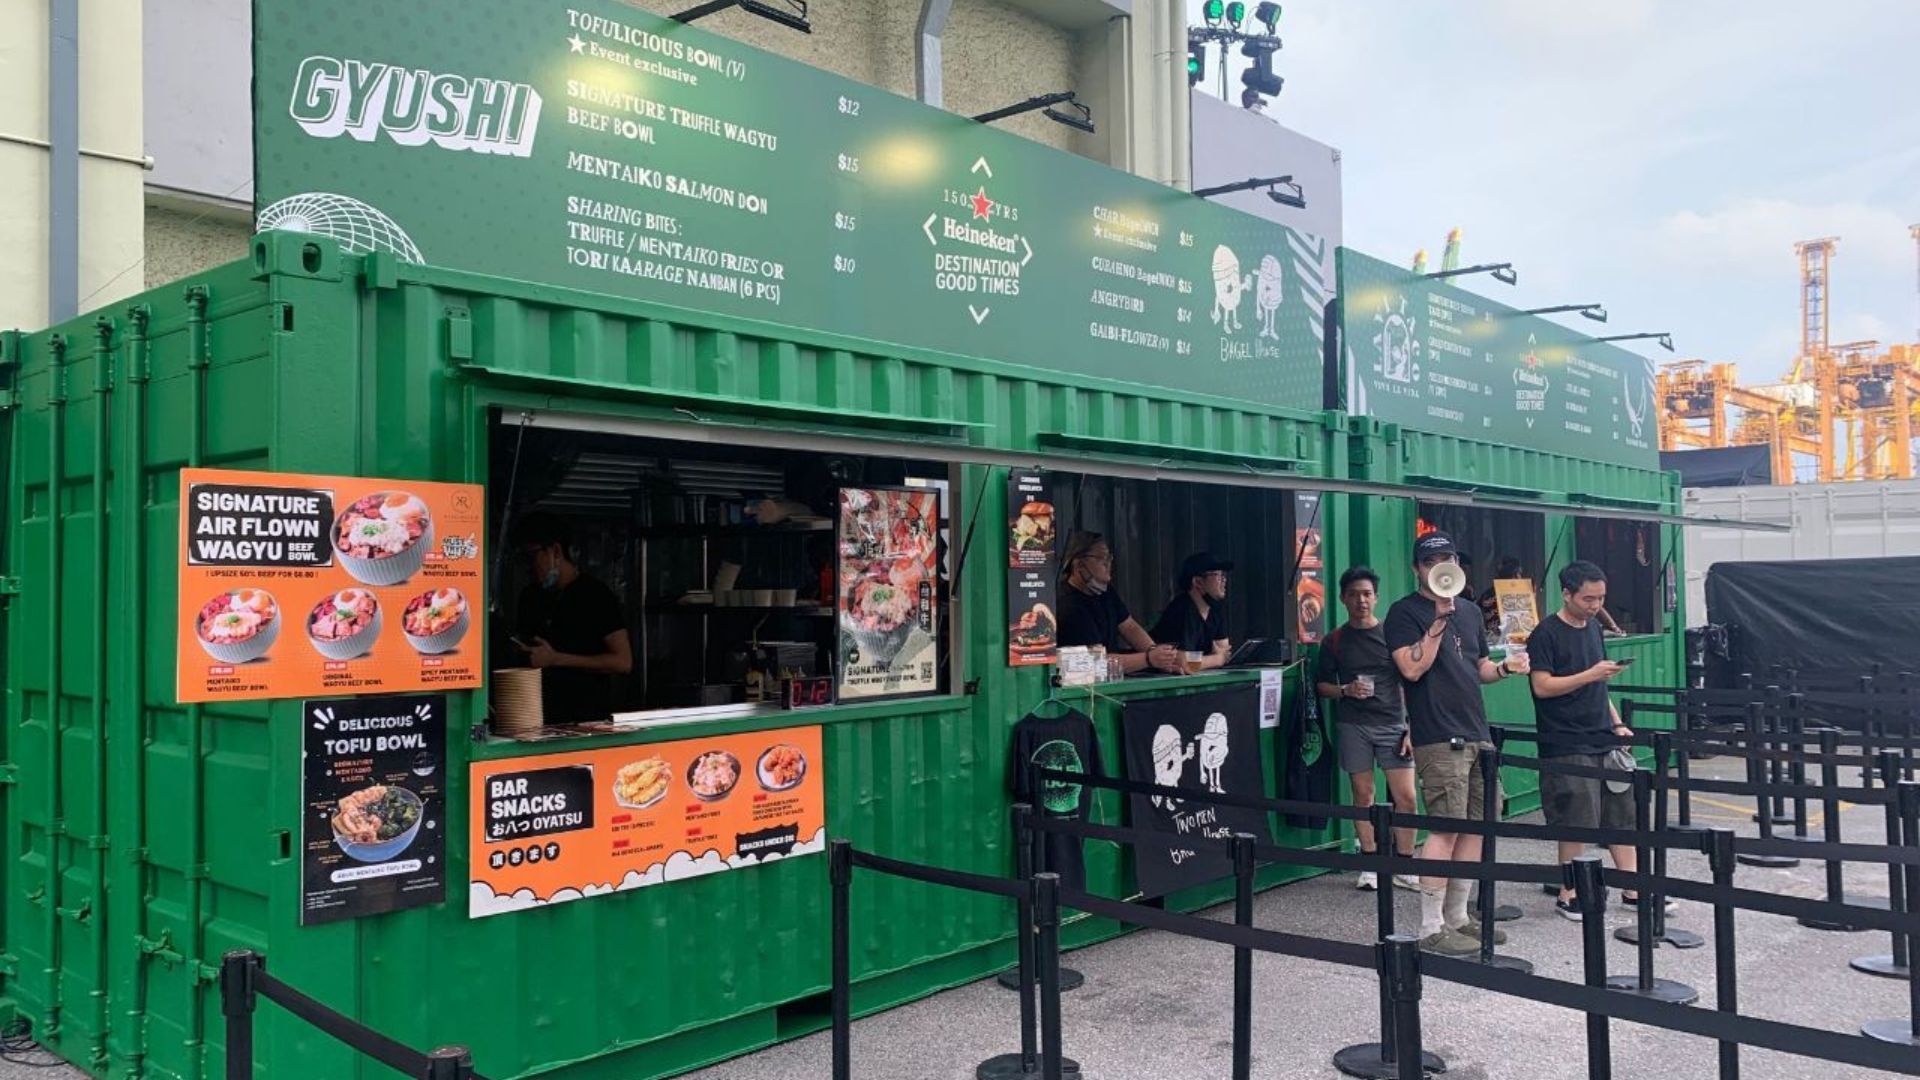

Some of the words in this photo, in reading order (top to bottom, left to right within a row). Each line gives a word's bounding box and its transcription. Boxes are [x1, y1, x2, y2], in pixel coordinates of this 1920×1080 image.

[566, 9, 683, 60] TOFULICIOUS
[687, 46, 725, 74] BOWL
[590, 41, 631, 66] Event
[634, 58, 698, 86] exclusive
[289, 55, 542, 158] GYUSHI
[567, 80, 666, 121] SIGNATURE
[670, 107, 721, 137] TRUFFLE
[723, 122, 777, 151] WAGYU
[838, 95, 861, 117] $12
[567, 107, 610, 132] BEEF
[614, 117, 656, 145] BOWL
[838, 152, 859, 173] $15
[567, 151, 662, 190] MENTAIKO
[665, 175, 735, 207] SALMON
[737, 192, 768, 216] DON
[567, 196, 641, 227] SHARING
[645, 212, 682, 237] BITES:
[944, 189, 967, 207] 150
[995, 203, 1018, 221] YRS
[835, 211, 856, 232] $15
[943, 217, 1016, 254] Heineken
[567, 221, 625, 249] TRUFFLE
[639, 235, 718, 267] MENTAIKO
[720, 252, 759, 275] FRIES
[761, 261, 785, 280] OR
[566, 246, 609, 271] TORI
[756, 282, 781, 306] PCS)
[834, 254, 856, 274] $10
[935, 253, 1020, 278] DESTINATION
[936, 272, 977, 292] GOOD
[981, 276, 1020, 296] TIMES
[1091, 289, 1145, 313] ANGRYBIRD
[197, 492, 319, 515] SIGNATURE
[196, 515, 236, 535] AIR
[241, 518, 319, 538] FLOWN
[196, 540, 282, 560] WAGYU
[288, 542, 314, 551] BEEF
[288, 551, 319, 561] BOWL
[339, 715, 414, 731] DELICIOUS
[324, 738, 372, 755] TOFU
[376, 733, 427, 751] BOWL
[491, 778, 528, 798] BAR
[491, 793, 566, 819] SNACKS
[492, 819, 531, 837] お八つ
[533, 812, 583, 831] OYATSU
